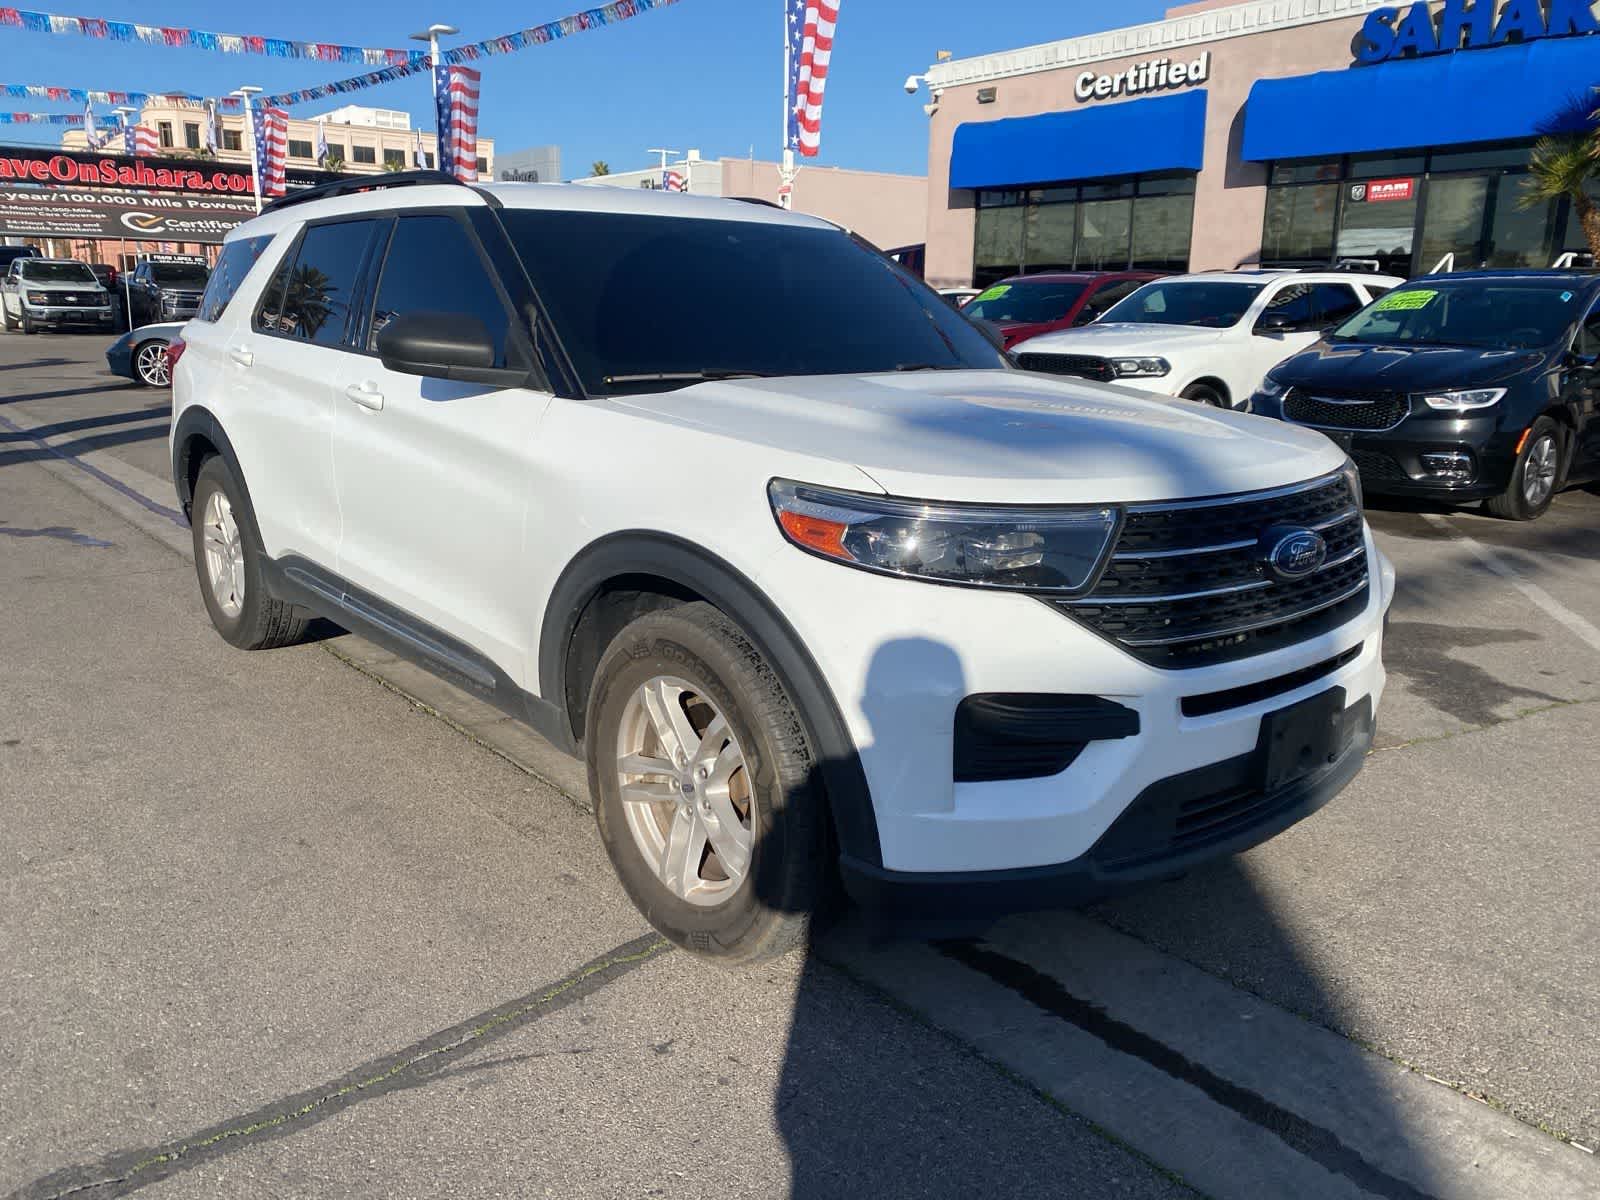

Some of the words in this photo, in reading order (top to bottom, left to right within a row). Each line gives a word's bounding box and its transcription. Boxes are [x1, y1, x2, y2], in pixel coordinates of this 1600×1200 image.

[1075, 50, 1210, 101] Certified
[1371, 183, 1409, 193] RAM
[141, 197, 182, 208] Mile
